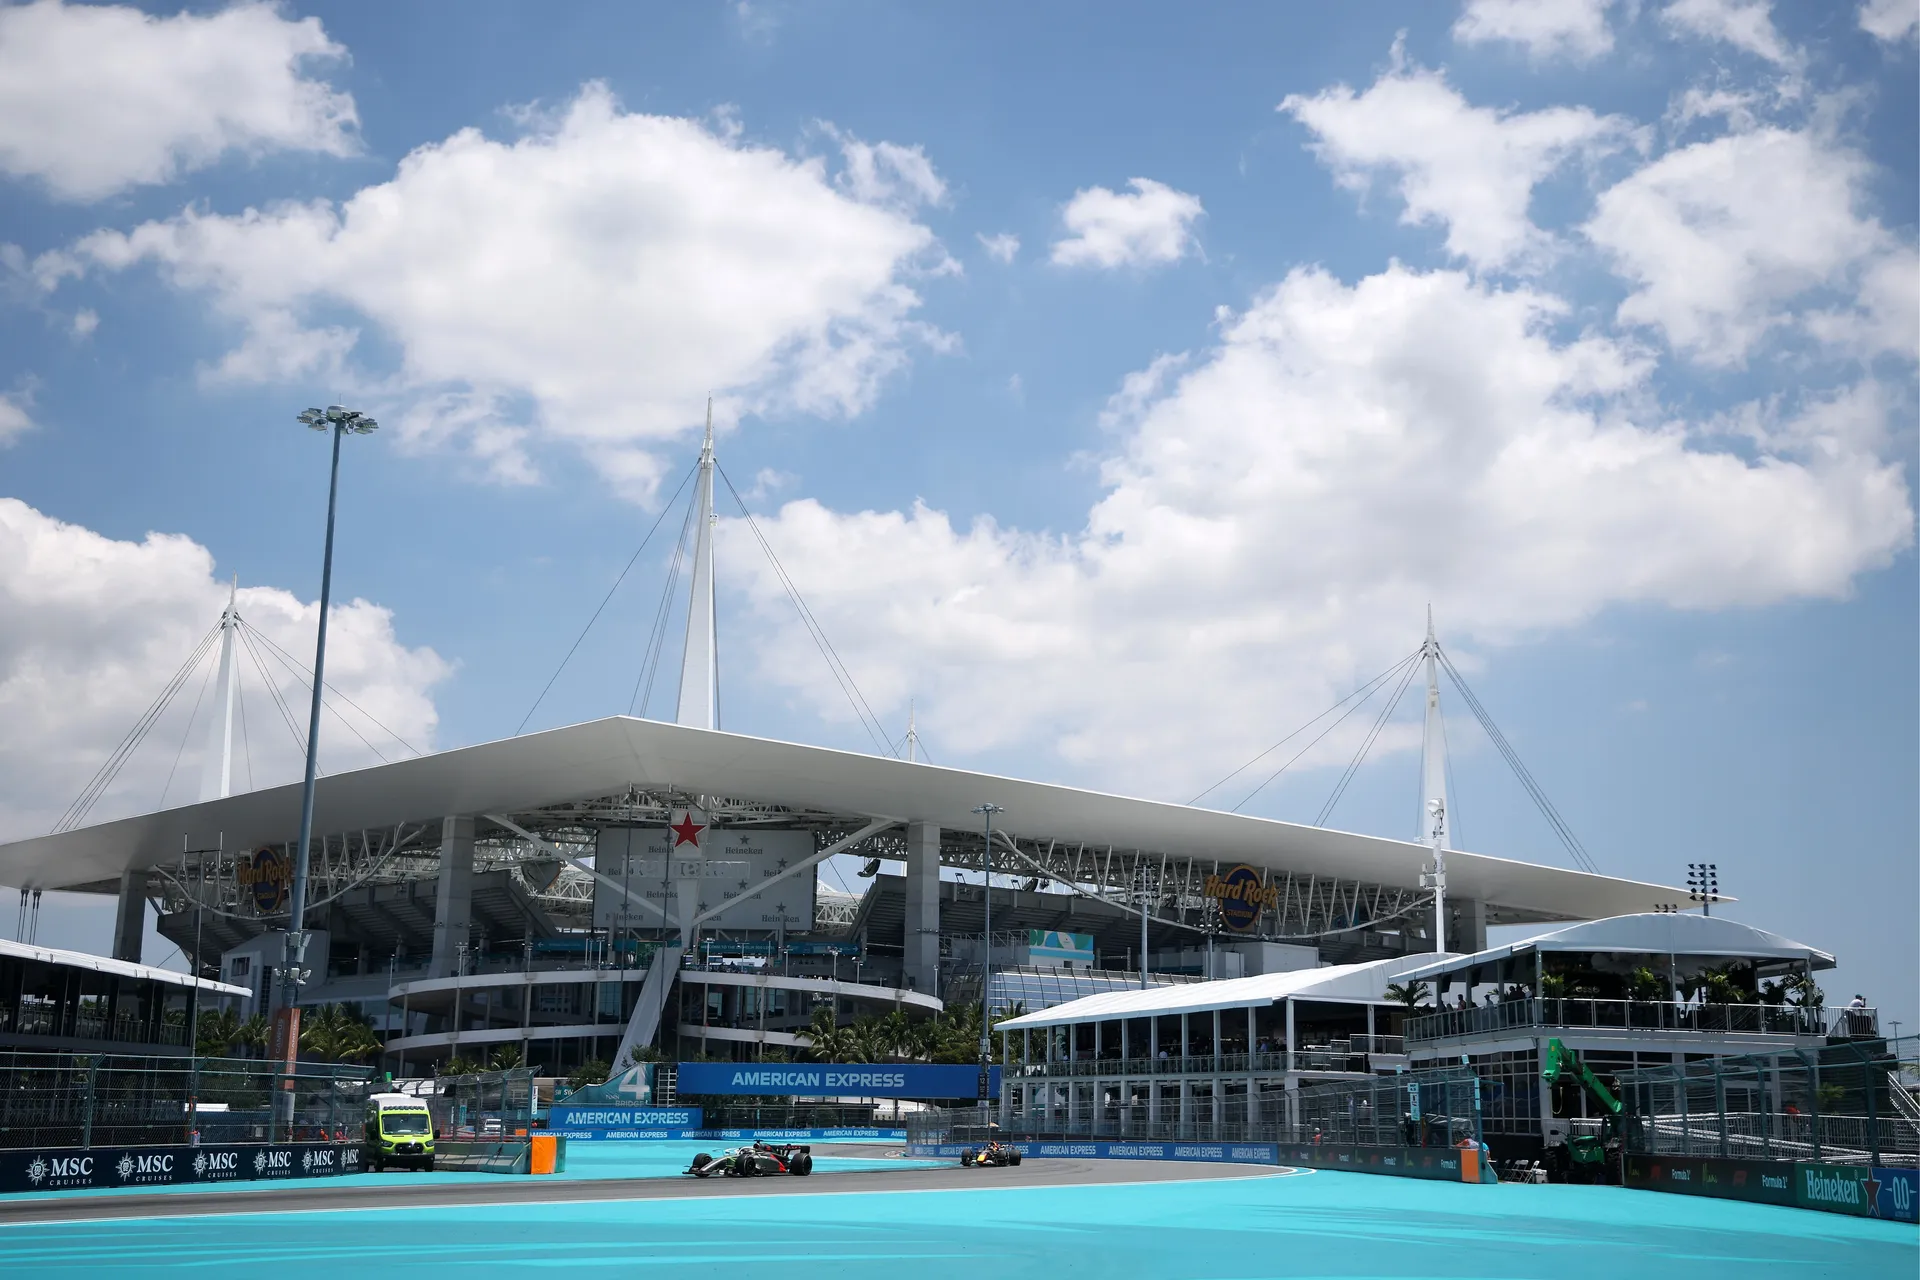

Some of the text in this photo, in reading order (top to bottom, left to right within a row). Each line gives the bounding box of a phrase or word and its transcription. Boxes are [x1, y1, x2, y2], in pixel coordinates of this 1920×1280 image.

[1204, 875, 1279, 909] Hard Rock
[1226, 910, 1253, 918] STADIUM
[618, 1063, 650, 1100] 4
[731, 1072, 905, 1088] AMERICAN EXPRESS
[565, 1112, 689, 1125] AMERICAN EXPRESS
[314, 1150, 334, 1166] MSC
[347, 1149, 359, 1164] MSC
[1040, 1146, 1096, 1155] AMERICAN EXPRESS
[1108, 1146, 1163, 1156] AMERICAN EXPRESS
[1175, 1146, 1222, 1158] AMERICAN EXPRESS
[1232, 1148, 1270, 1159] AMERICAN EXPRESS
[50, 1157, 94, 1176] MSC
[136, 1155, 174, 1173] MSC
[209, 1152, 238, 1169] MSC
[268, 1152, 292, 1168] MSC
[1672, 1168, 1686, 1180] Formula
[1762, 1174, 1782, 1188] Formula
[1806, 1170, 1859, 1204] Heineken
[1893, 1176, 1910, 1210] 0.0
